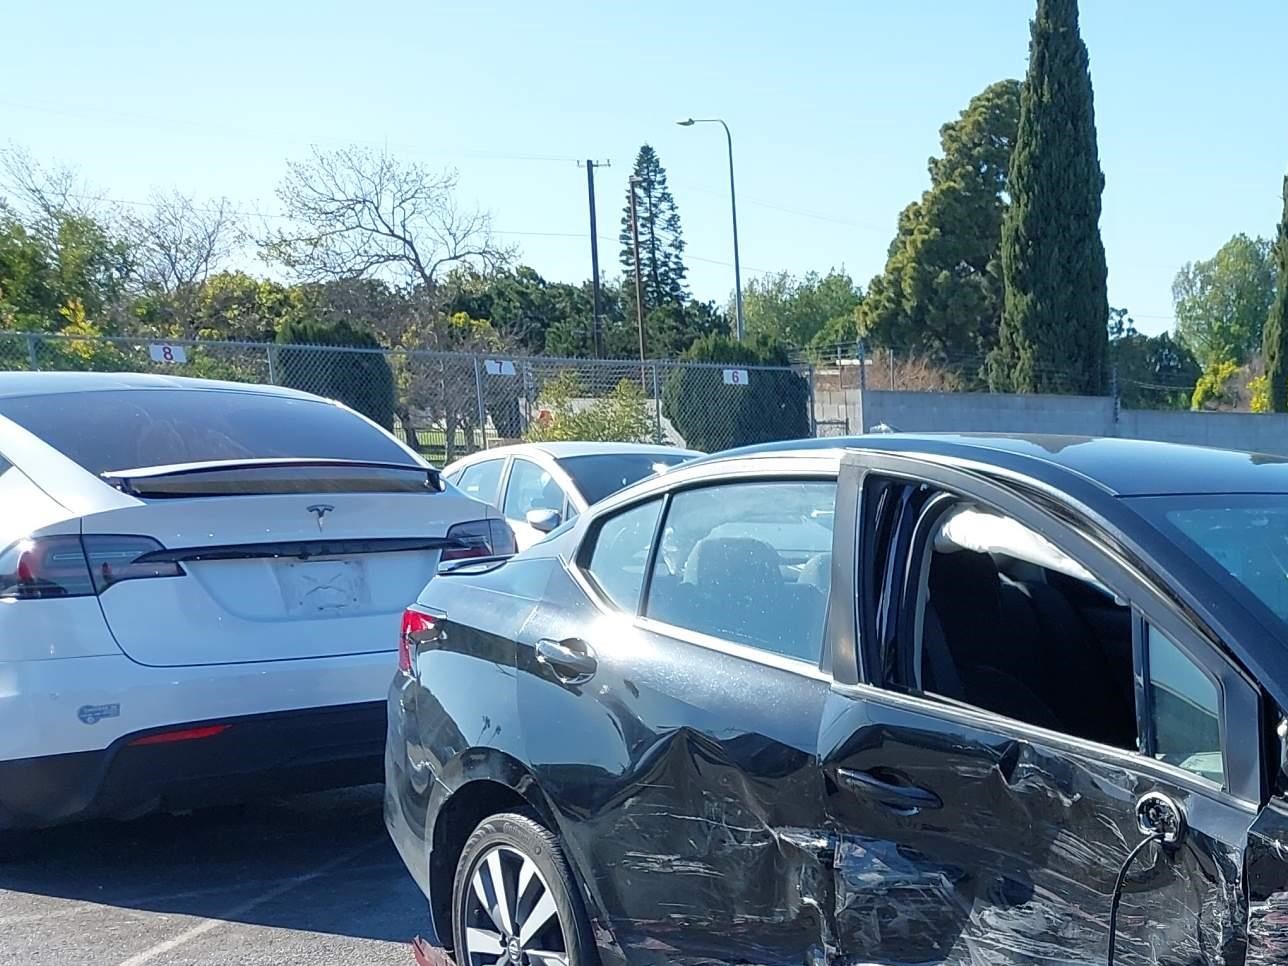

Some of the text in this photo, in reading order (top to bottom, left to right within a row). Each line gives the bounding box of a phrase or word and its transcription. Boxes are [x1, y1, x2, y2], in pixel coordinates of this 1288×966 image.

[162, 346, 174, 361] 8
[495, 361, 503, 374] 7
[731, 370, 740, 384] 6
